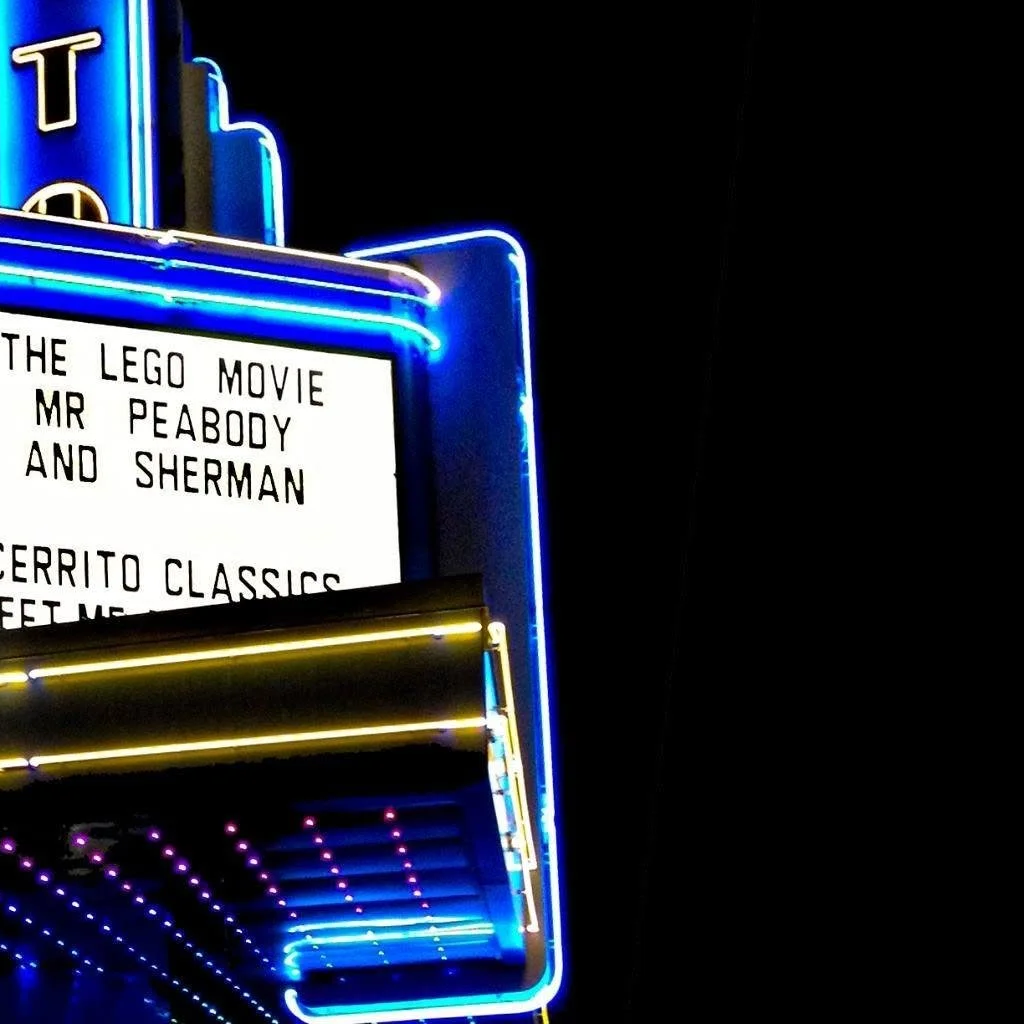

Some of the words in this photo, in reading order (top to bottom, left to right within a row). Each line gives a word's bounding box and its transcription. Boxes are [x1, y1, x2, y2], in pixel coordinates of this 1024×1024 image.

[1, 332, 67, 377] THE
[101, 342, 185, 389] LEGO
[218, 357, 324, 407] MOVIE
[36, 388, 85, 430] MR
[130, 397, 291, 452] PEABODY
[25, 440, 98, 484] AND
[135, 450, 305, 506] SHERMAN
